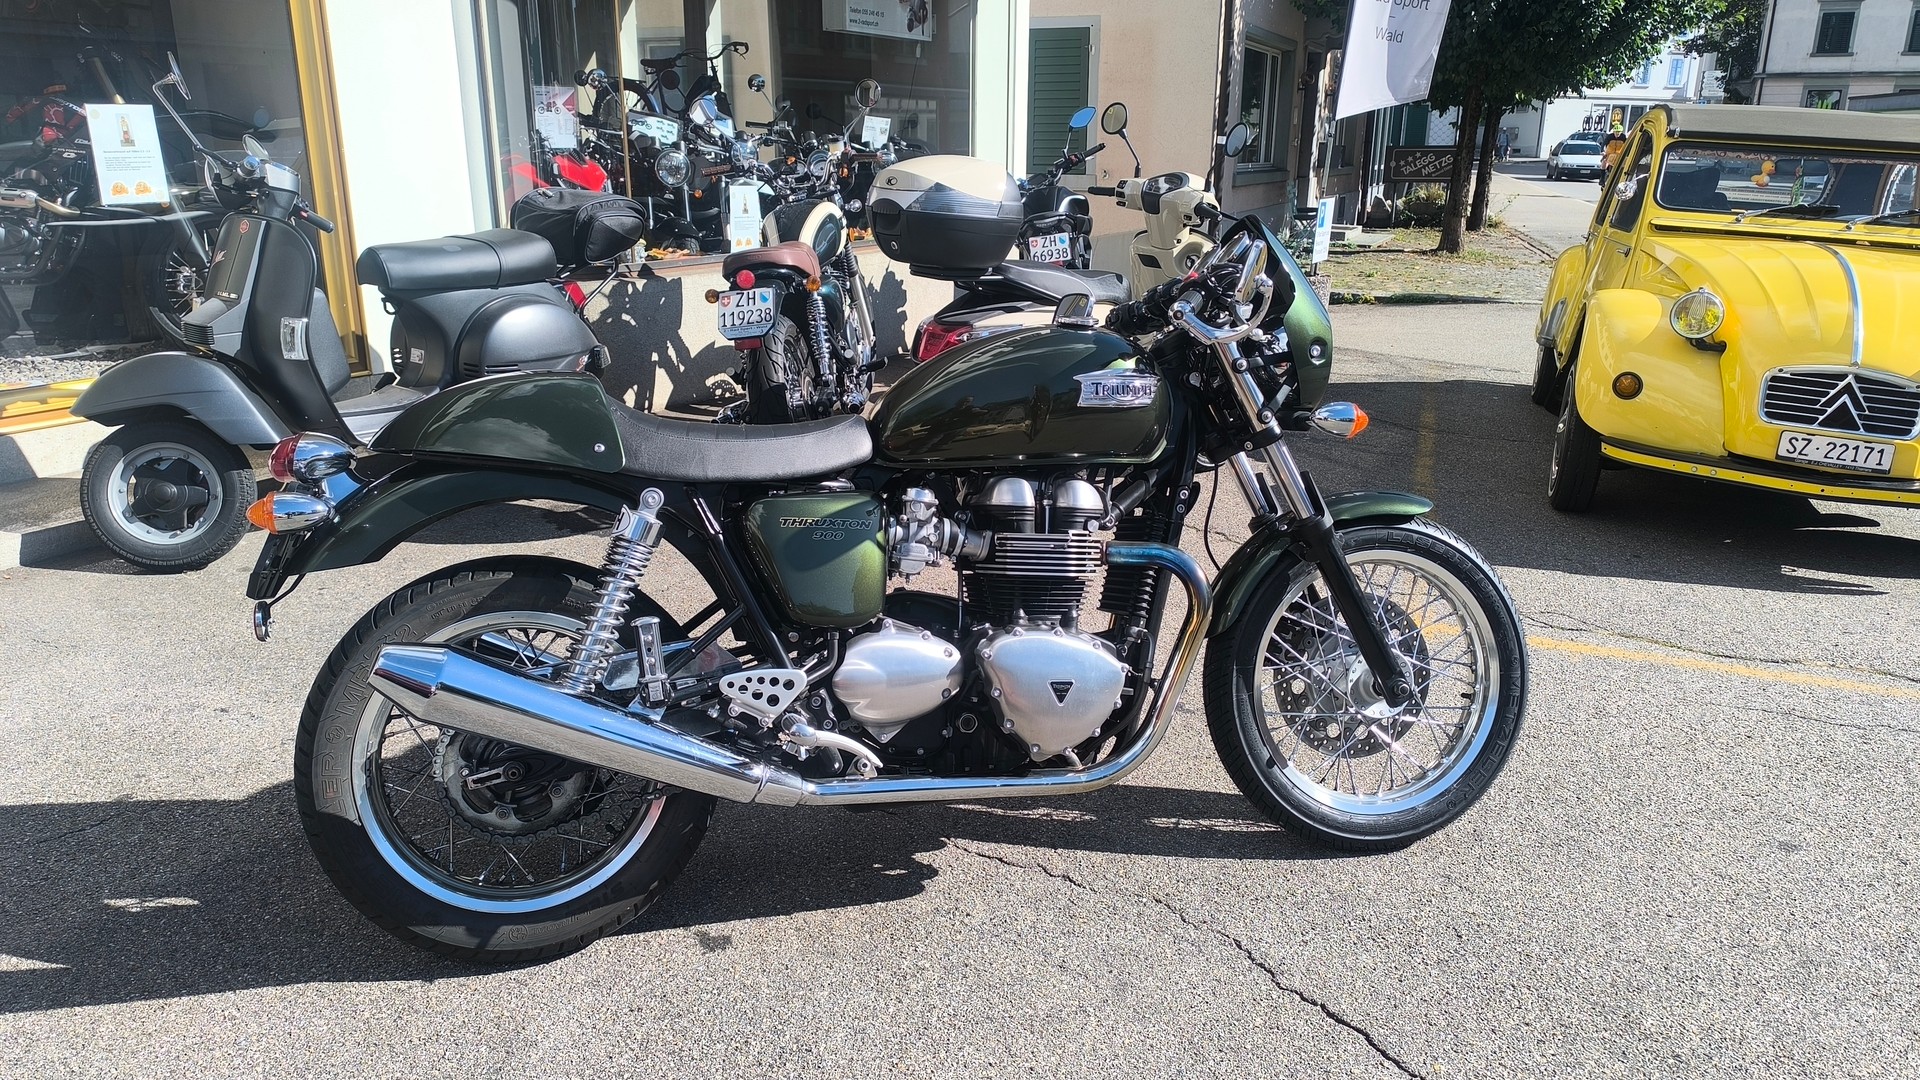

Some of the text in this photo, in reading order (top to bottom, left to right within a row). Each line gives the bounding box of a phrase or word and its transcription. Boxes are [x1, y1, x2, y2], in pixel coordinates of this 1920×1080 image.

[1375, 26, 1404, 43] Wald
[1401, 153, 1435, 175] TALEGG
[1421, 154, 1454, 176] METZG
[1041, 236, 1057, 248] ZH
[1033, 247, 1069, 262] 66938
[736, 291, 756, 307] ZH
[720, 308, 772, 327] 119238
[1091, 382, 1152, 398] TRIUMPH
[780, 516, 873, 530] THRUXTON
[812, 530, 845, 541] 900
[1386, 531, 1491, 592] LASERTEC
[1459, 673, 1521, 798] METZELER
